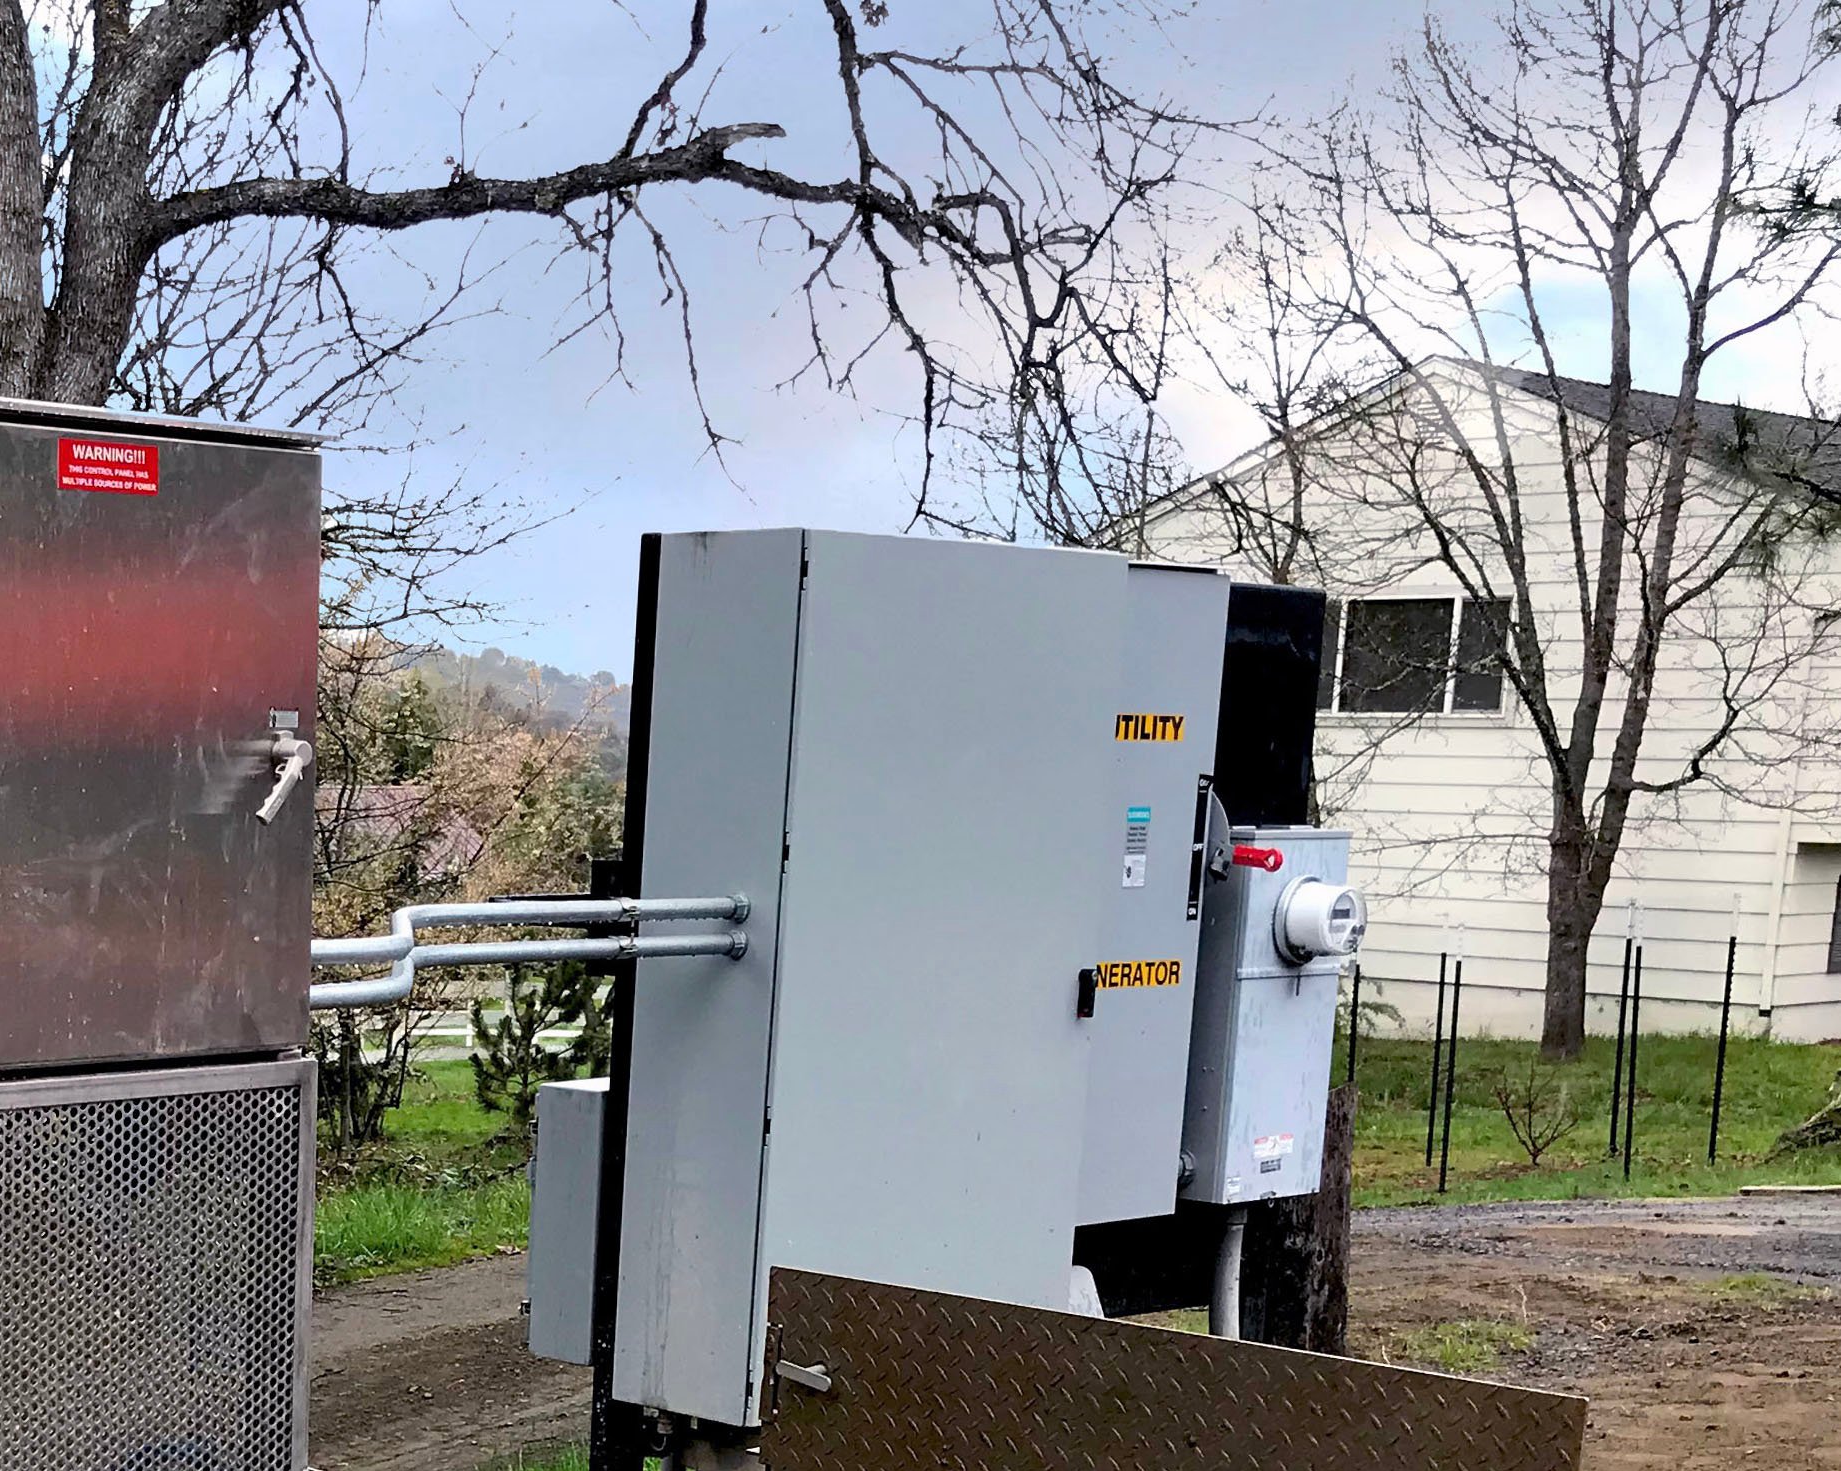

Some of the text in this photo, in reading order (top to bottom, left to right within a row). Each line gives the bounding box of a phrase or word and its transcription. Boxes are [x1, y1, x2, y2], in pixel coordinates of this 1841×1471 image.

[73, 444, 145, 465] WARNING!!!
[68, 464, 149, 479] THIS CONTROL PANEL HAS
[62, 476, 157, 492] MULTIPLE SOURCES OF POWER
[1095, 960, 1181, 988] NERATOR
